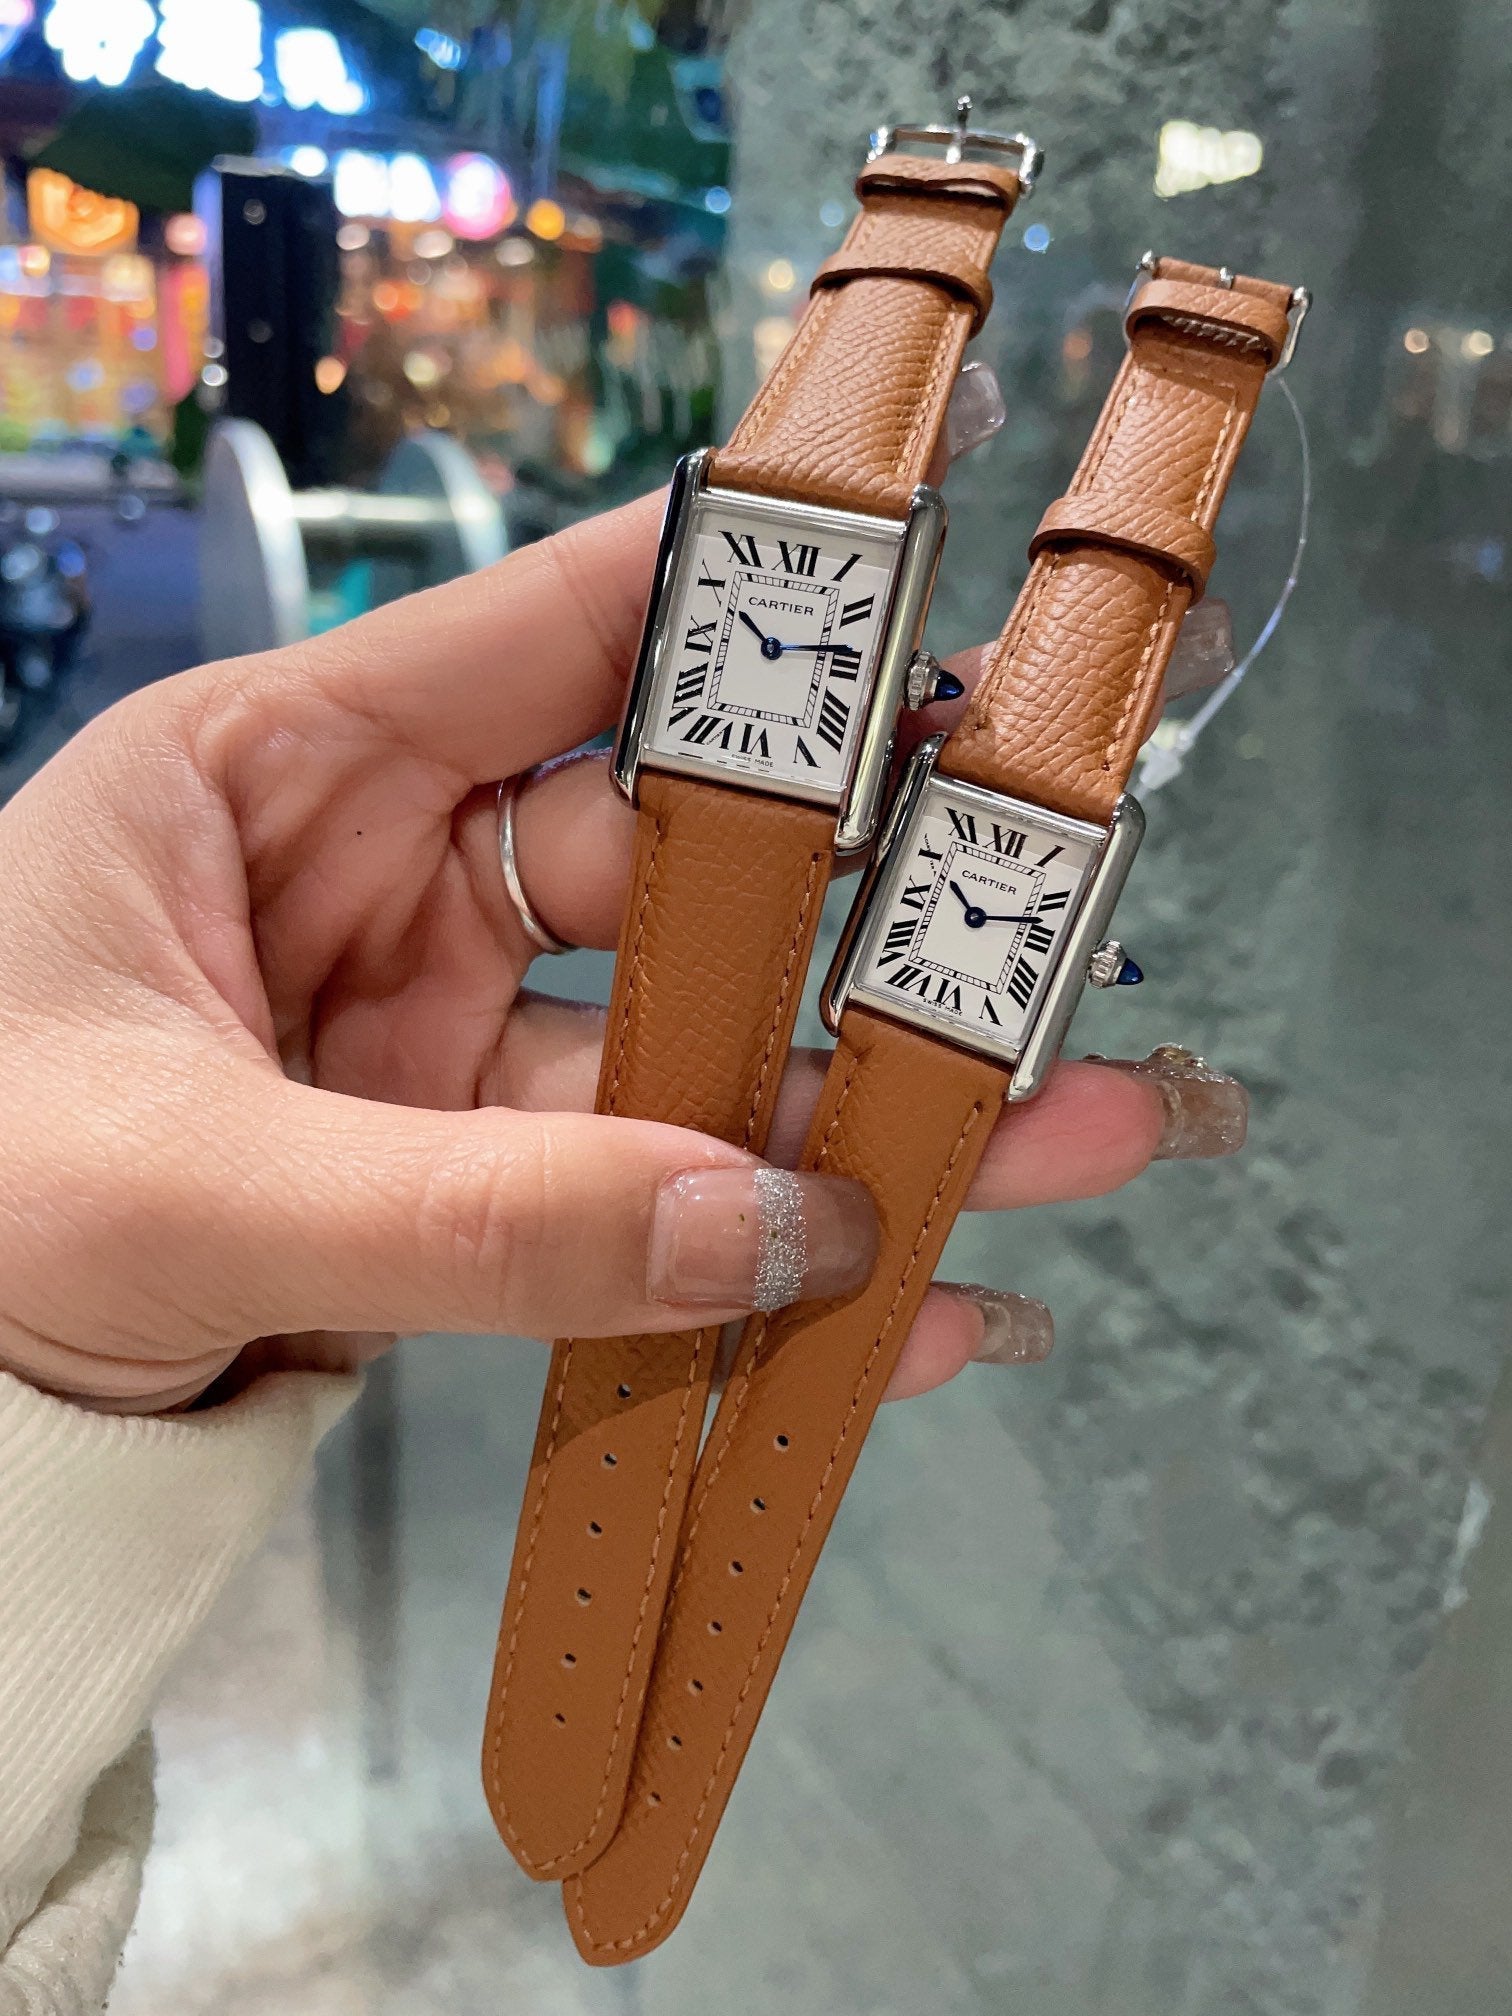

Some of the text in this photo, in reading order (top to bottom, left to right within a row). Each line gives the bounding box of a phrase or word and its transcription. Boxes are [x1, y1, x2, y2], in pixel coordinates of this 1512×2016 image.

[772, 540, 822, 577] XII
[749, 596, 814, 616] CARTIER
[754, 758, 774, 768] MADE
[984, 823, 1028, 859] XII
[962, 870, 1017, 895] CARTIER
